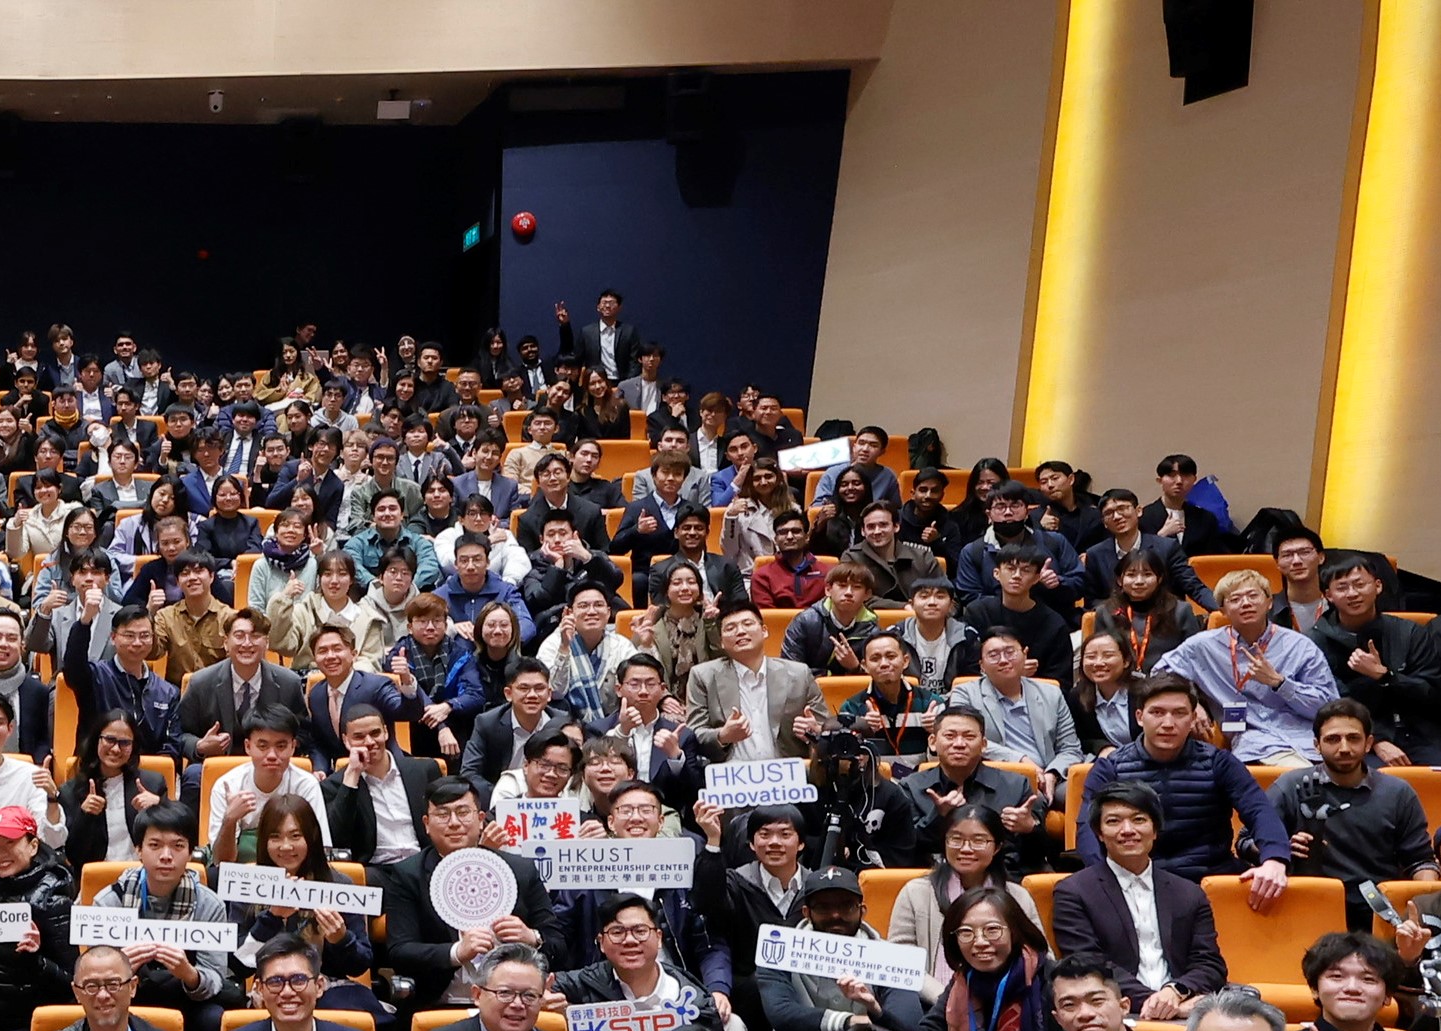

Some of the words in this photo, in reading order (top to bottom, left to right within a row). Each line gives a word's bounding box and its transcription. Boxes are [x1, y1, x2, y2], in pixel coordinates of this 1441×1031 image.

[923, 660, 934, 674] B
[711, 761, 800, 787] HKUST
[701, 785, 816, 807] Innovation
[517, 801, 558, 810] HKUST
[558, 847, 634, 863] HKUST
[558, 864, 651, 872] ENTREPRENEURSHIP
[653, 863, 689, 872] CENTER
[224, 870, 251, 879] HONG
[253, 872, 279, 882] KONG
[0, 909, 29, 923] Core
[75, 913, 102, 922] HONG
[105, 914, 132, 923] KONG
[792, 935, 868, 959] HKUST
[790, 950, 883, 971] ENTREPRENEURSHIP
[884, 964, 921, 977] CENTER
[570, 1004, 632, 1022] 香港科技園
